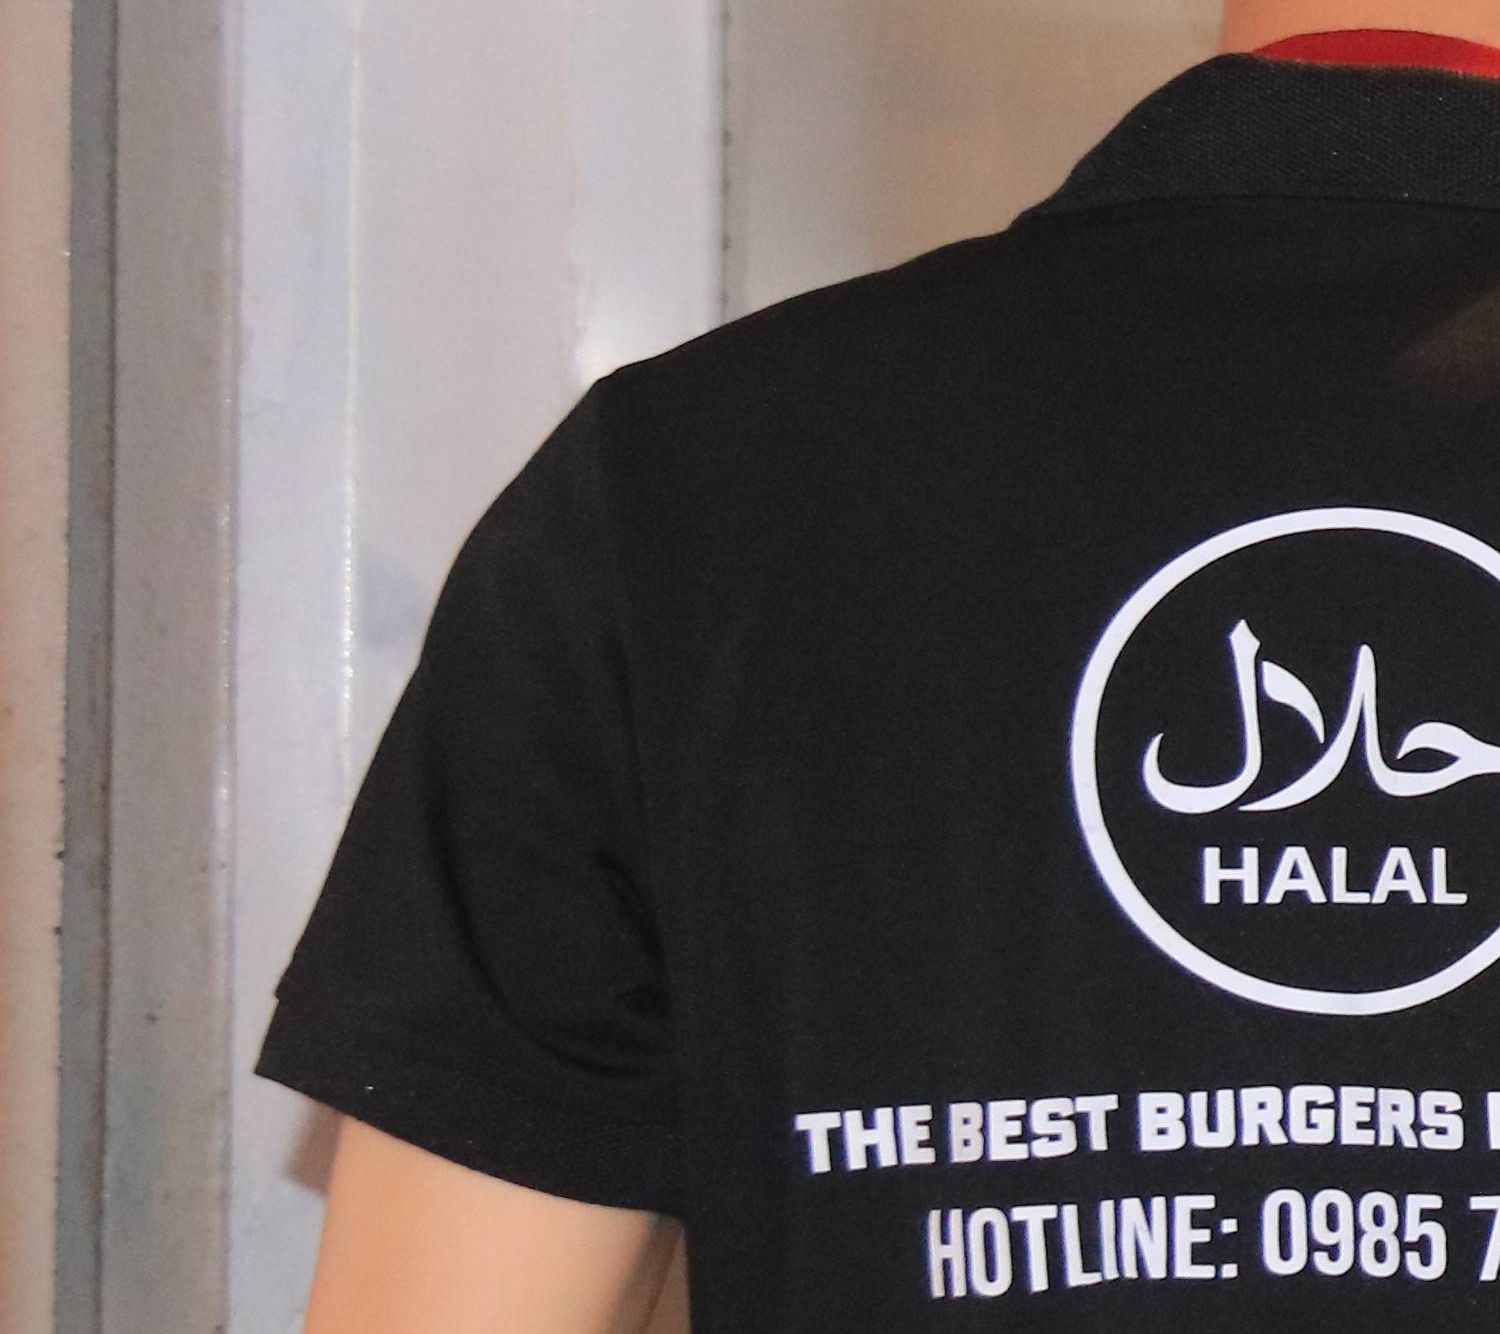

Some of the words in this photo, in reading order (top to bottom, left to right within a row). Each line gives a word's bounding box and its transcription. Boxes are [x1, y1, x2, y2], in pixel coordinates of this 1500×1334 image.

[1202, 846, 1468, 905] HALAL
[793, 1104, 936, 1174] THE
[948, 1091, 1119, 1164] BEST
[1137, 1084, 1464, 1152] BURGERS
[926, 1194, 1238, 1298] HOTLINE:
[1261, 1188, 1447, 1281] 0985
